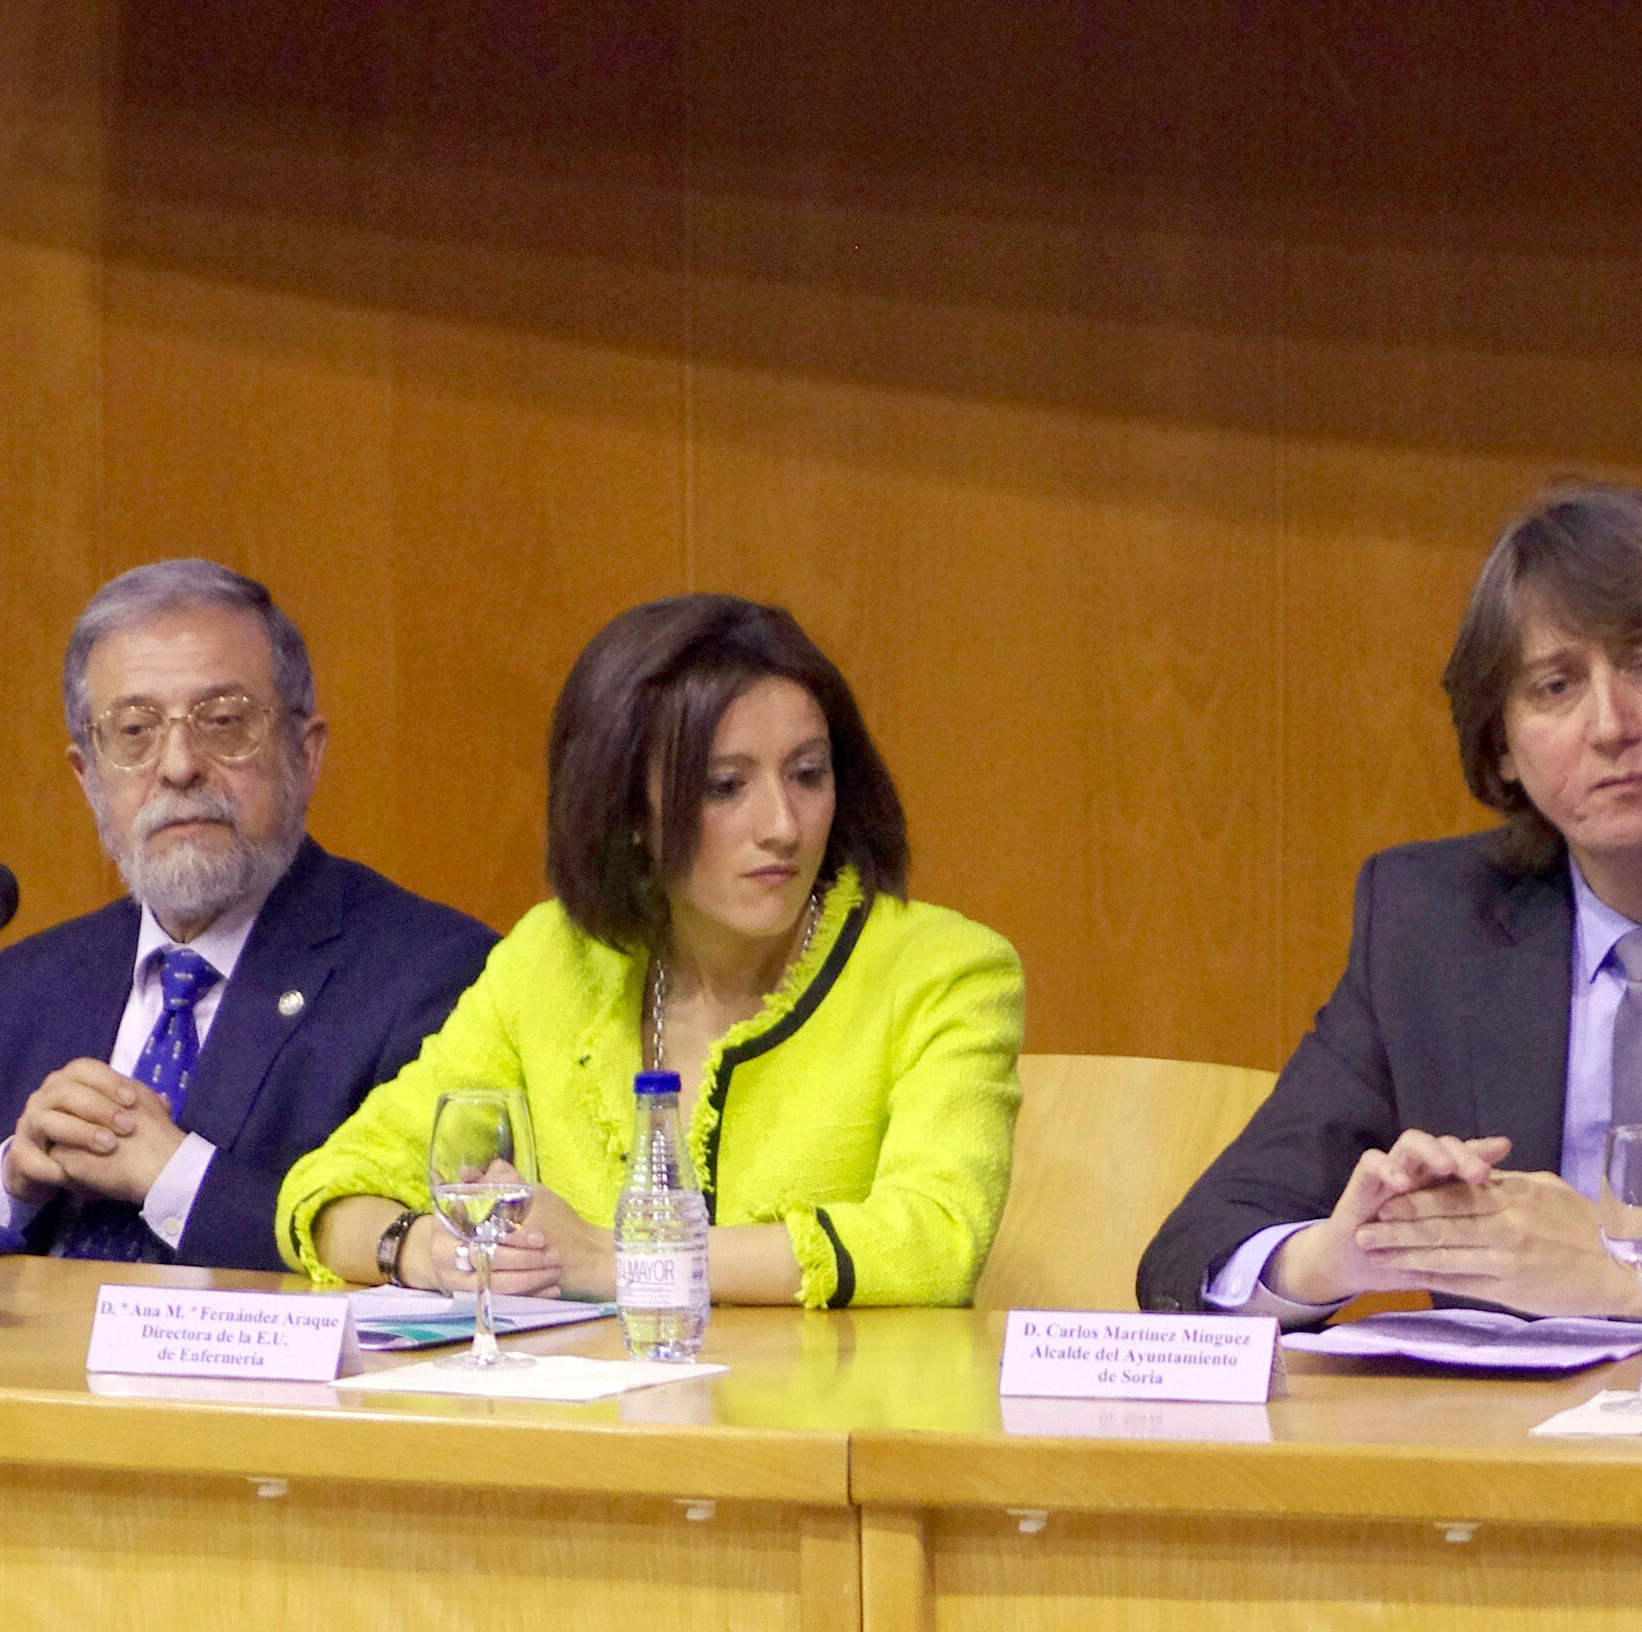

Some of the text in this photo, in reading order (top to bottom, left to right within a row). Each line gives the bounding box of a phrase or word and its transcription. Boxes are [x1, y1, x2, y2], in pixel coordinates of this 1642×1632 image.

[130, 1303, 160, 1317] Ana
[200, 1306, 278, 1325] Fernández
[284, 1312, 339, 1331] Araque
[142, 1324, 289, 1346] Directora de la E.U.
[1024, 1322, 1040, 1337] D.
[1047, 1323, 1098, 1339] Carlos
[1105, 1326, 1176, 1342] Martínez
[158, 1347, 264, 1366] de Enfermería
[1031, 1345, 1237, 1366] Alcalde del Ayuntamiento
[1098, 1369, 1163, 1385] de Soria
